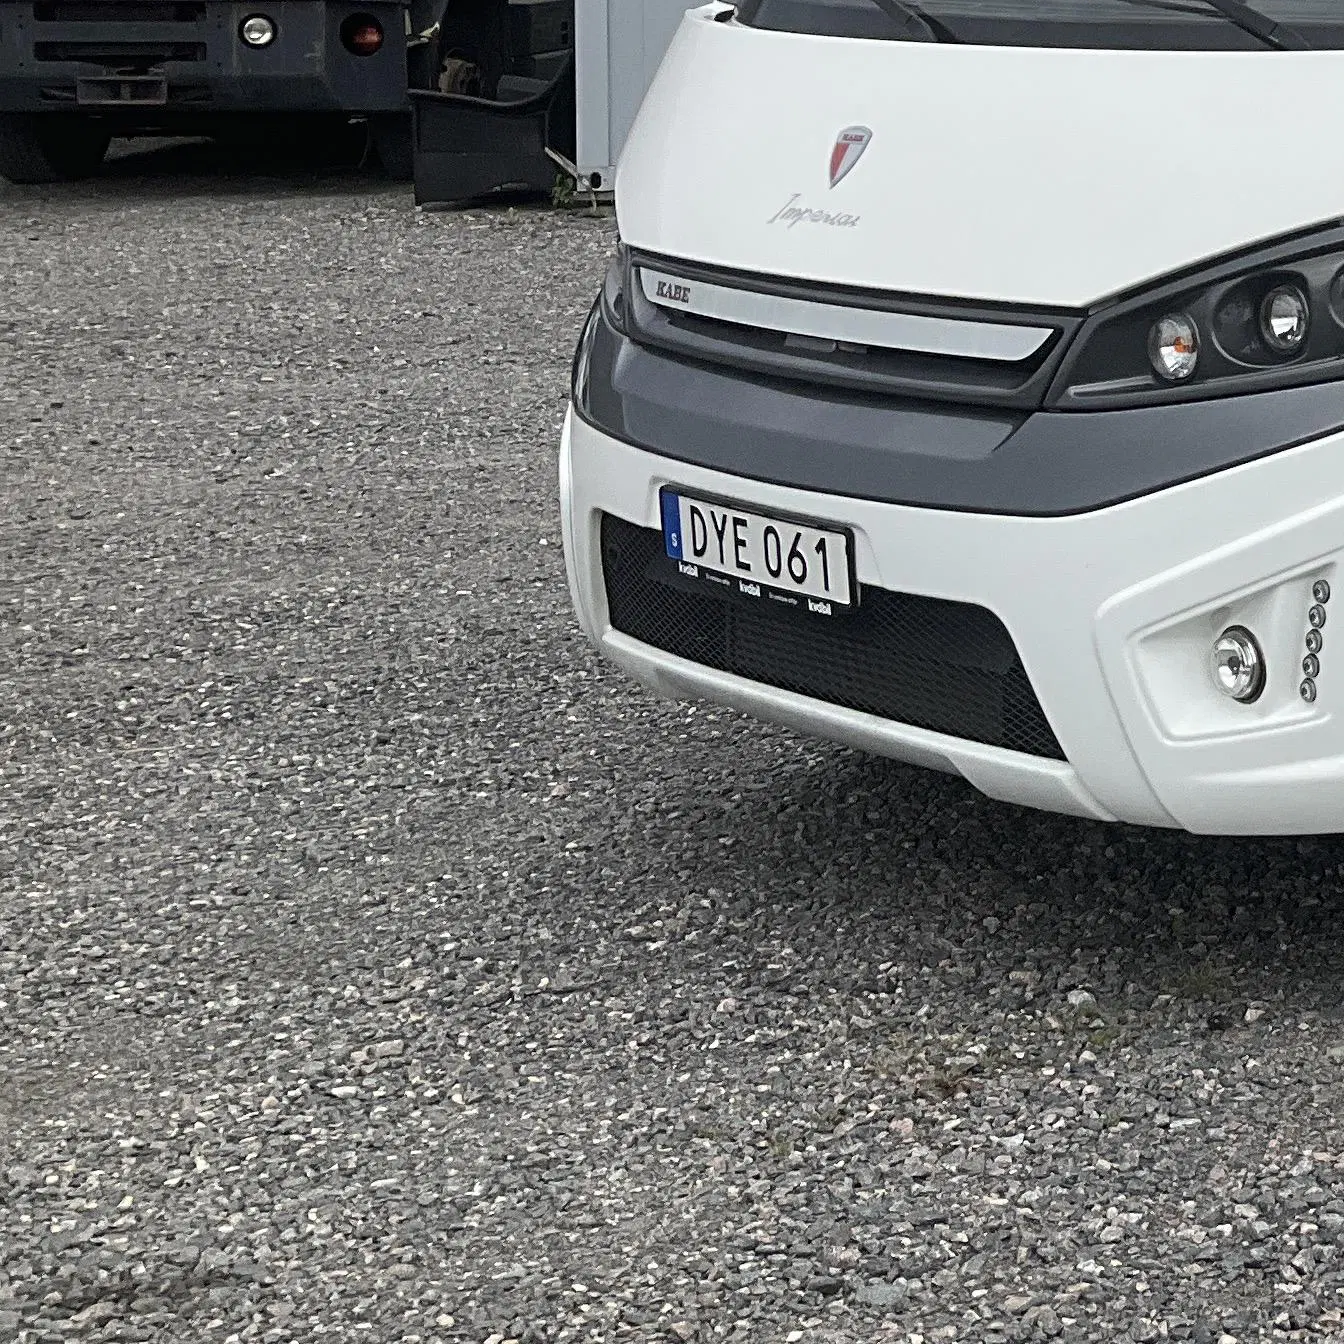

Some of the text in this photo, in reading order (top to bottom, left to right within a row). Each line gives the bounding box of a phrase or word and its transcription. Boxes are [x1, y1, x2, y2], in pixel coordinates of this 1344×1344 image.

[655, 280, 691, 305] KABE
[689, 504, 830, 592] DYE 061
